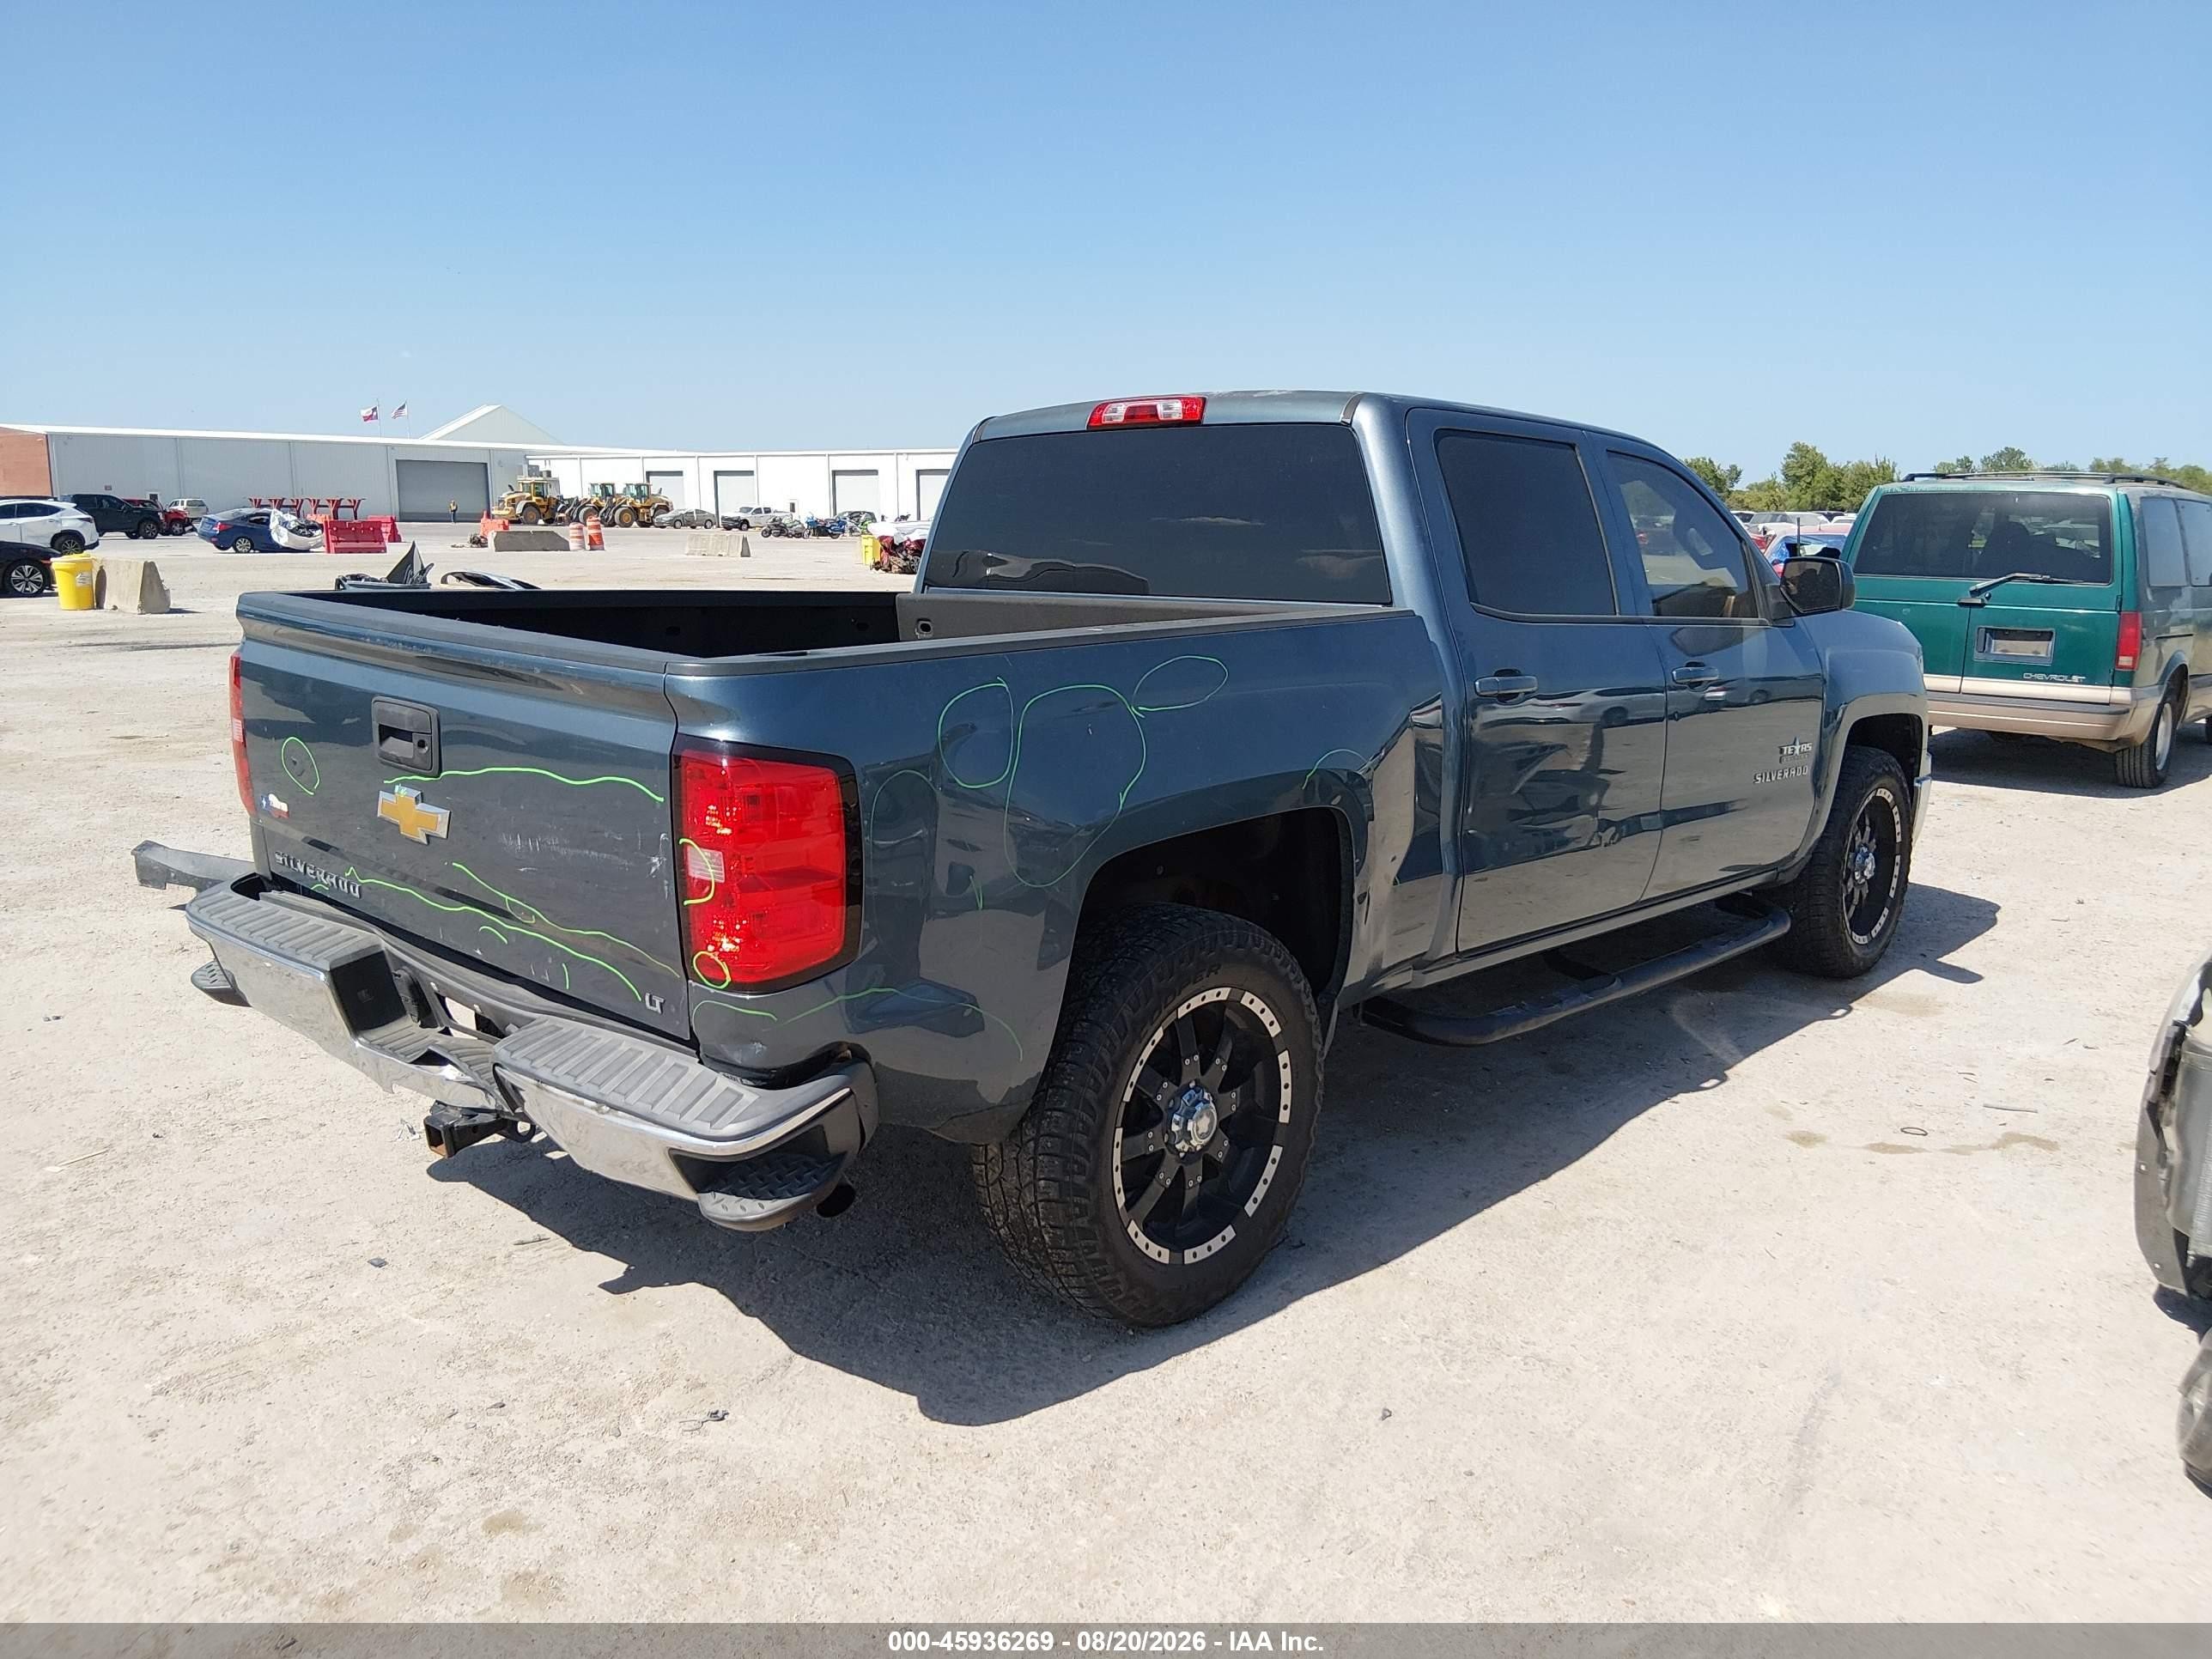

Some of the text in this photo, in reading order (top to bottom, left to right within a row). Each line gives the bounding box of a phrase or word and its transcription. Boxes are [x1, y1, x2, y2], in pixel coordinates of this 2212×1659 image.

[2023, 672, 2087, 683] CHEVROLET
[1781, 740, 1813, 756] TEXAS
[1753, 766, 1808, 784] SILVERADO
[275, 851, 362, 899] SILVERADO
[645, 992, 665, 1014] LT
